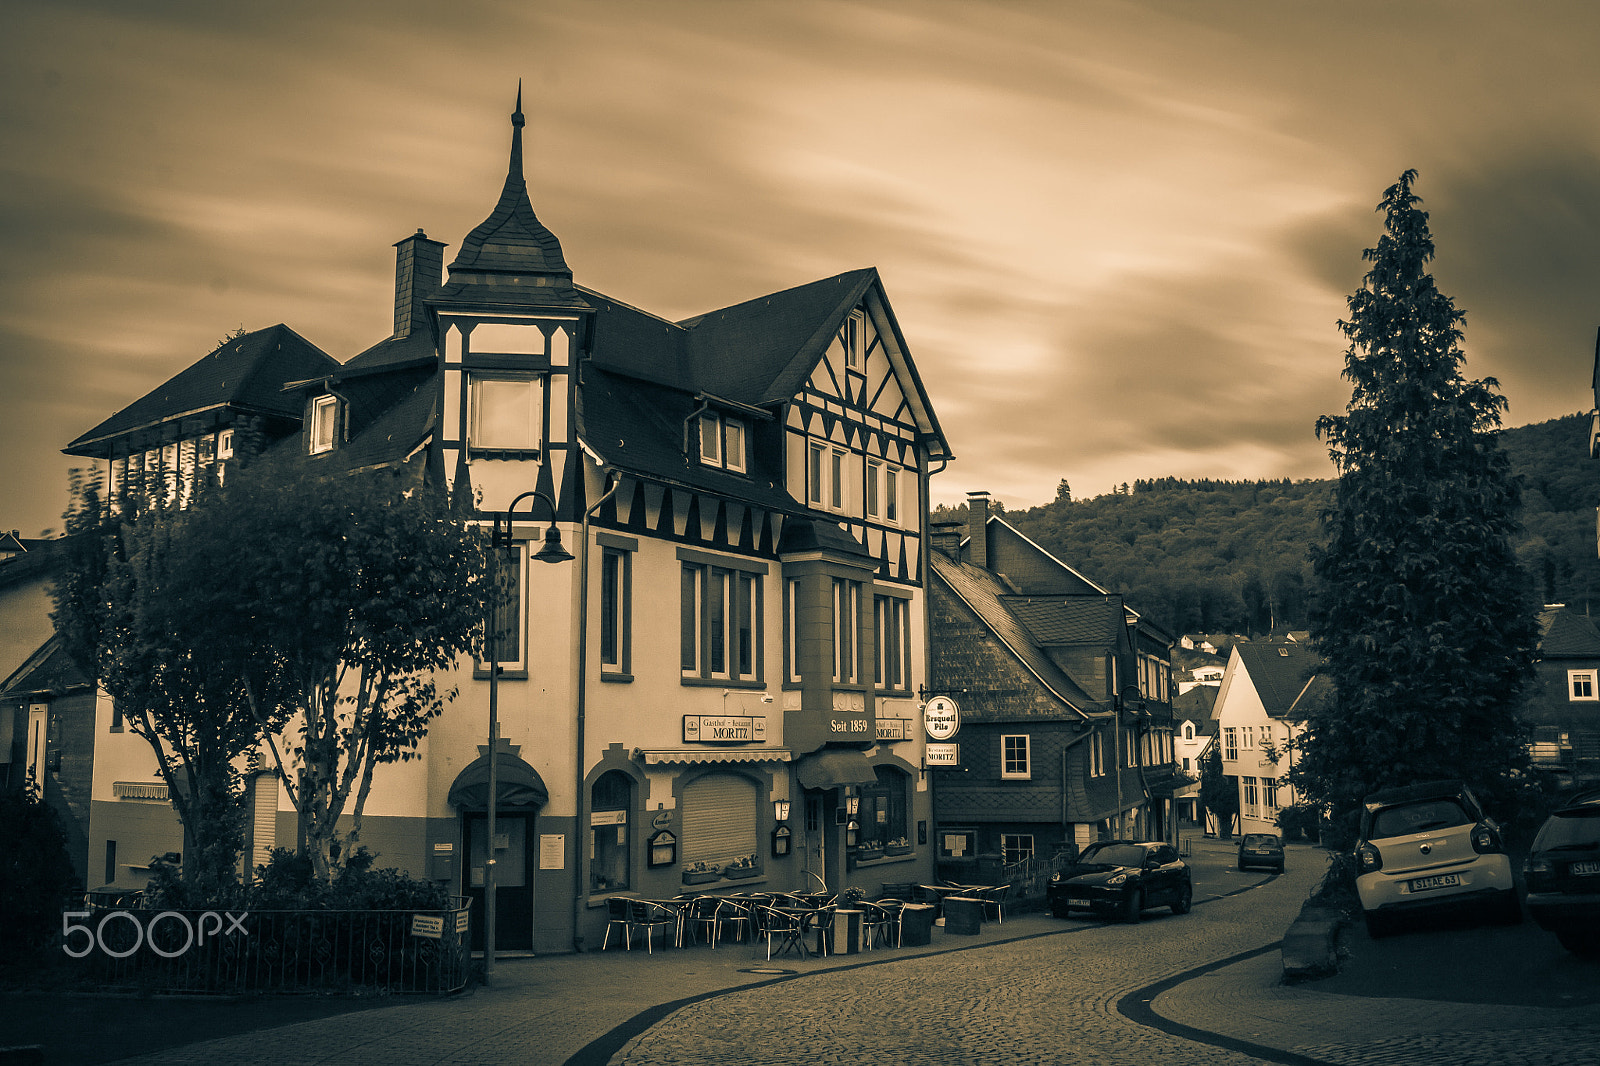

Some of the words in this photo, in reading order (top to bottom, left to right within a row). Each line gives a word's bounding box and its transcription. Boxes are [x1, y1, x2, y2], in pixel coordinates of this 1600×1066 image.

[831, 719, 847, 732] Seit
[850, 719, 868, 732] 1859
[713, 728, 748, 739] MORITZ
[876, 728, 901, 738] MORITZ
[928, 753, 954, 761] MORITZ
[1416, 879, 1428, 889] SI
[1445, 875, 1456, 885] 63
